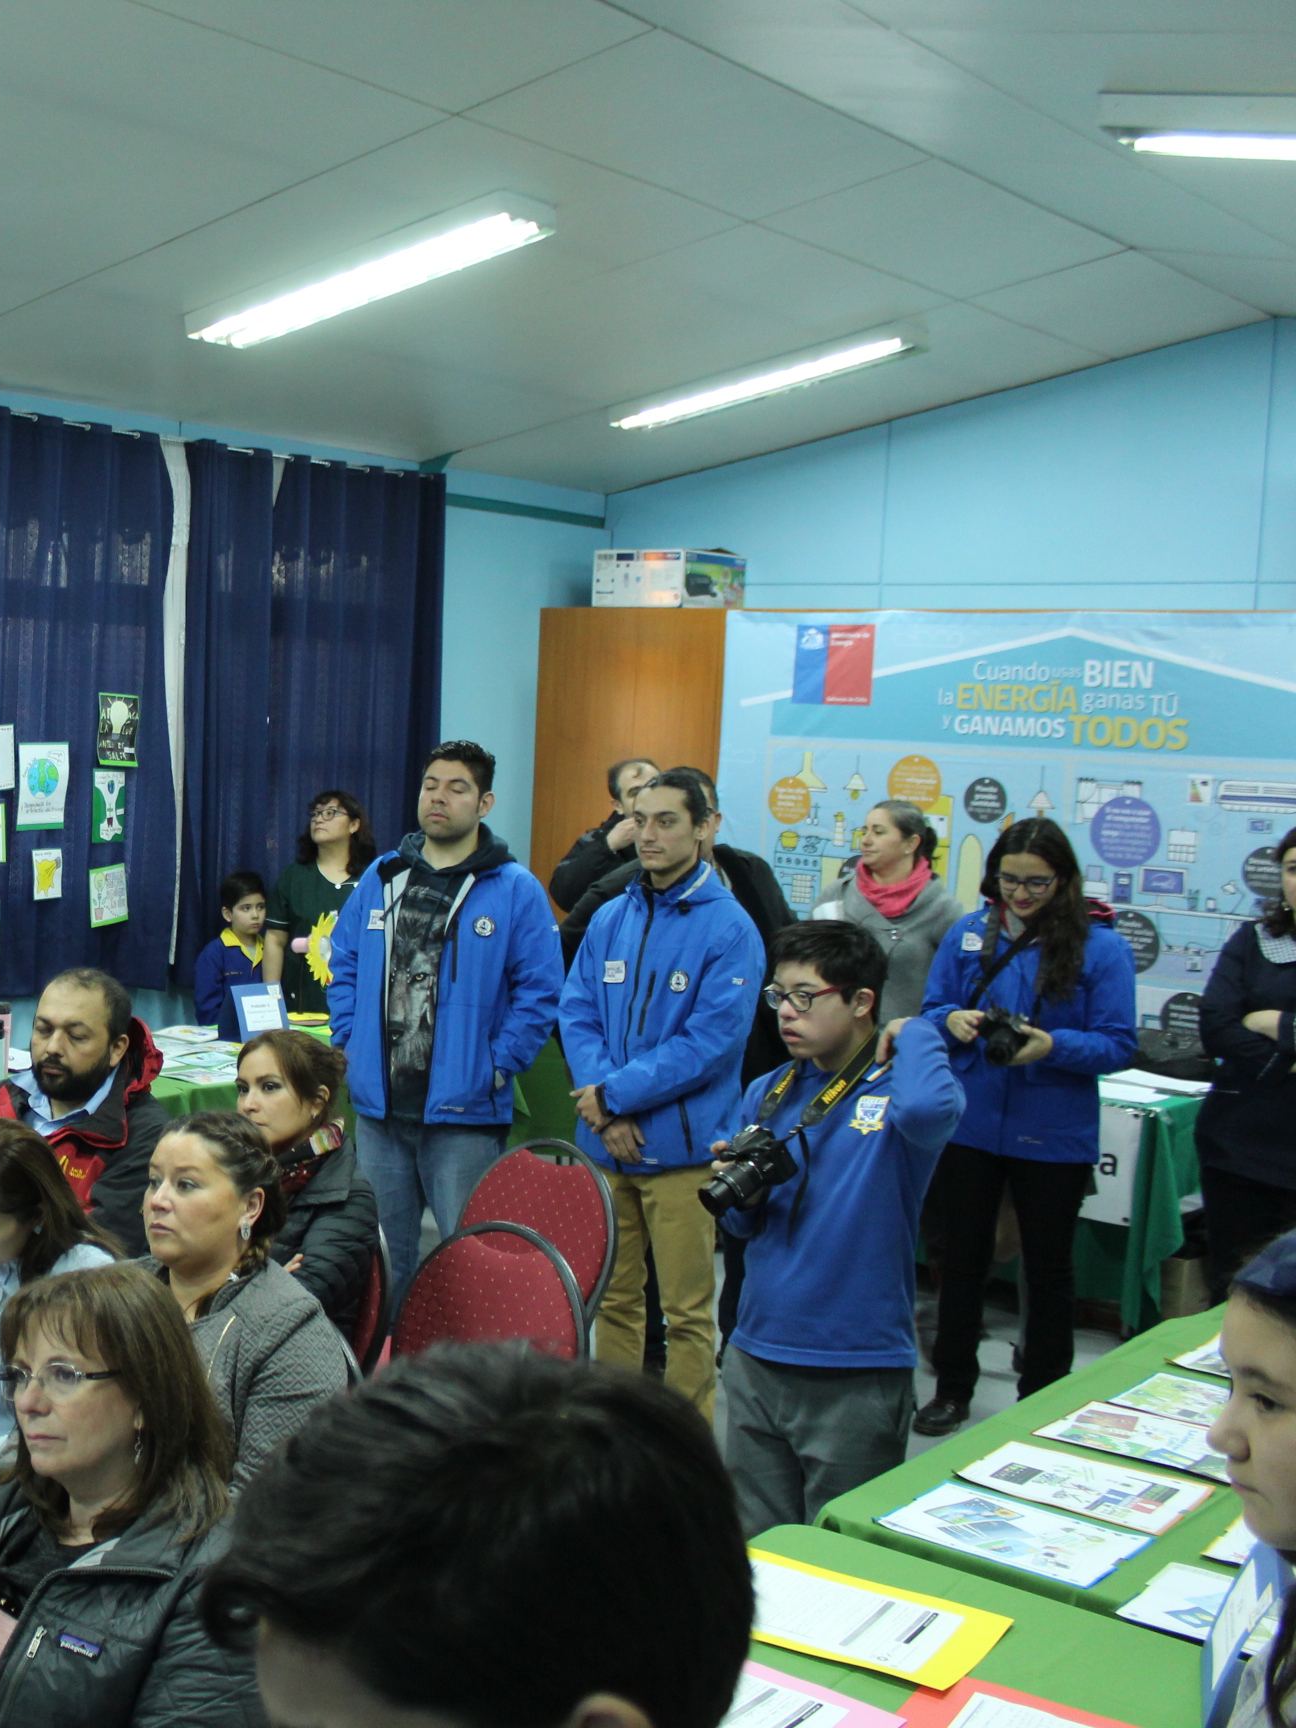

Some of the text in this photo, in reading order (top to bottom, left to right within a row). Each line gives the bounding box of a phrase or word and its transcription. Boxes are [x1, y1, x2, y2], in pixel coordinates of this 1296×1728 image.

[973, 659, 1154, 689] Cuando usas BIEN
[938, 681, 1180, 717] la ENERGÍA ganas TÚ
[942, 715, 1189, 750] y GANAMOS TODOS
[821, 1079, 848, 1105] Nikon
[60, 1640, 94, 1658] patagonia
